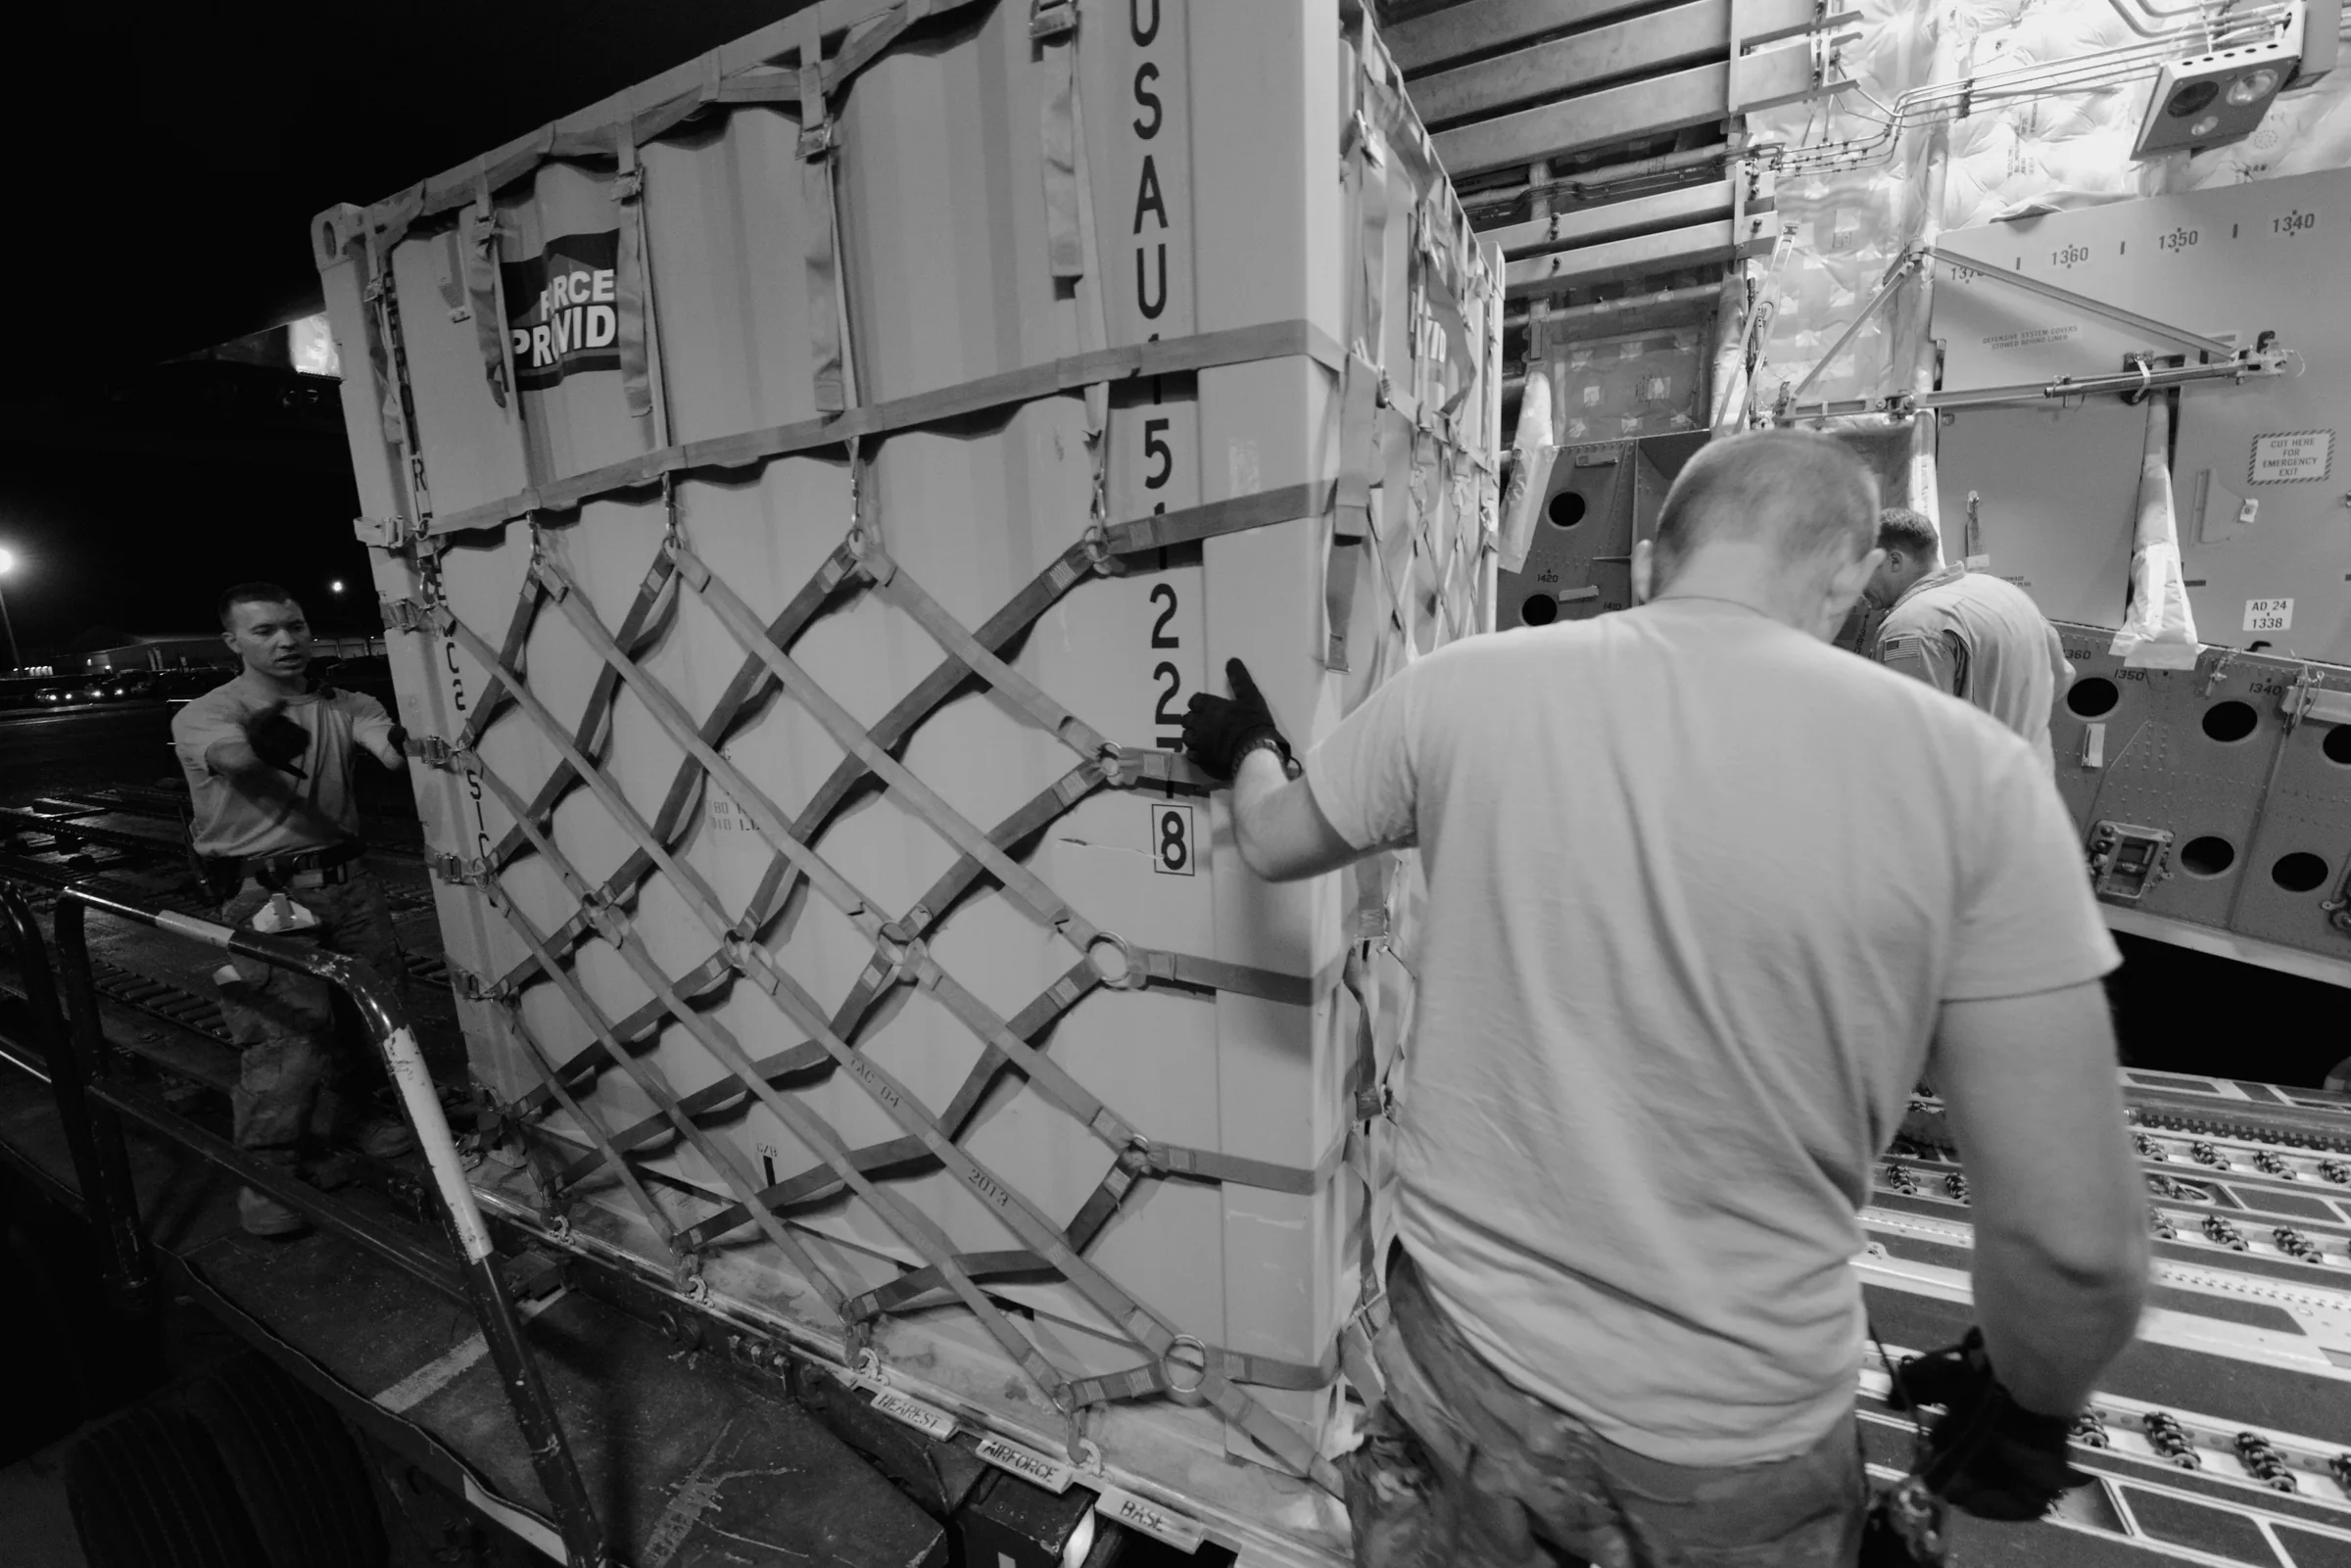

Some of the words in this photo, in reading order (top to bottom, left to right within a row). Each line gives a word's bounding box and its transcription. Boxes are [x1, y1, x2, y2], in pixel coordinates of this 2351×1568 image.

[2272, 214, 2316, 232] 1340
[2158, 231, 2198, 249] 1350
[2051, 247, 2088, 265] 1360
[1983, 333, 2018, 345] DEFENSIVE
[2021, 328, 2048, 339] SYSTEM
[2050, 325, 2078, 336] COVERS
[1991, 341, 2019, 350] STOWED
[2021, 337, 2046, 346] BEHIND
[2047, 334, 2068, 343] LINER
[2270, 439, 2288, 449] CUT
[2291, 438, 2315, 448] HERE
[2282, 449, 2300, 457] FOR
[2263, 456, 2318, 467] EMERGENCY
[2278, 467, 2298, 477] EXIT
[1537, 574, 1559, 583] 1420
[2251, 601, 2267, 611] AD
[2272, 600, 2287, 611] 24
[2251, 618, 2282, 629] 1338
[2114, 669, 2145, 682] 1350
[2249, 683, 2281, 695] 1340
[877, 1394, 944, 1430] NEAREST
[983, 1441, 1061, 1484] AIRFORCE
[1119, 1498, 1166, 1533] BASE
